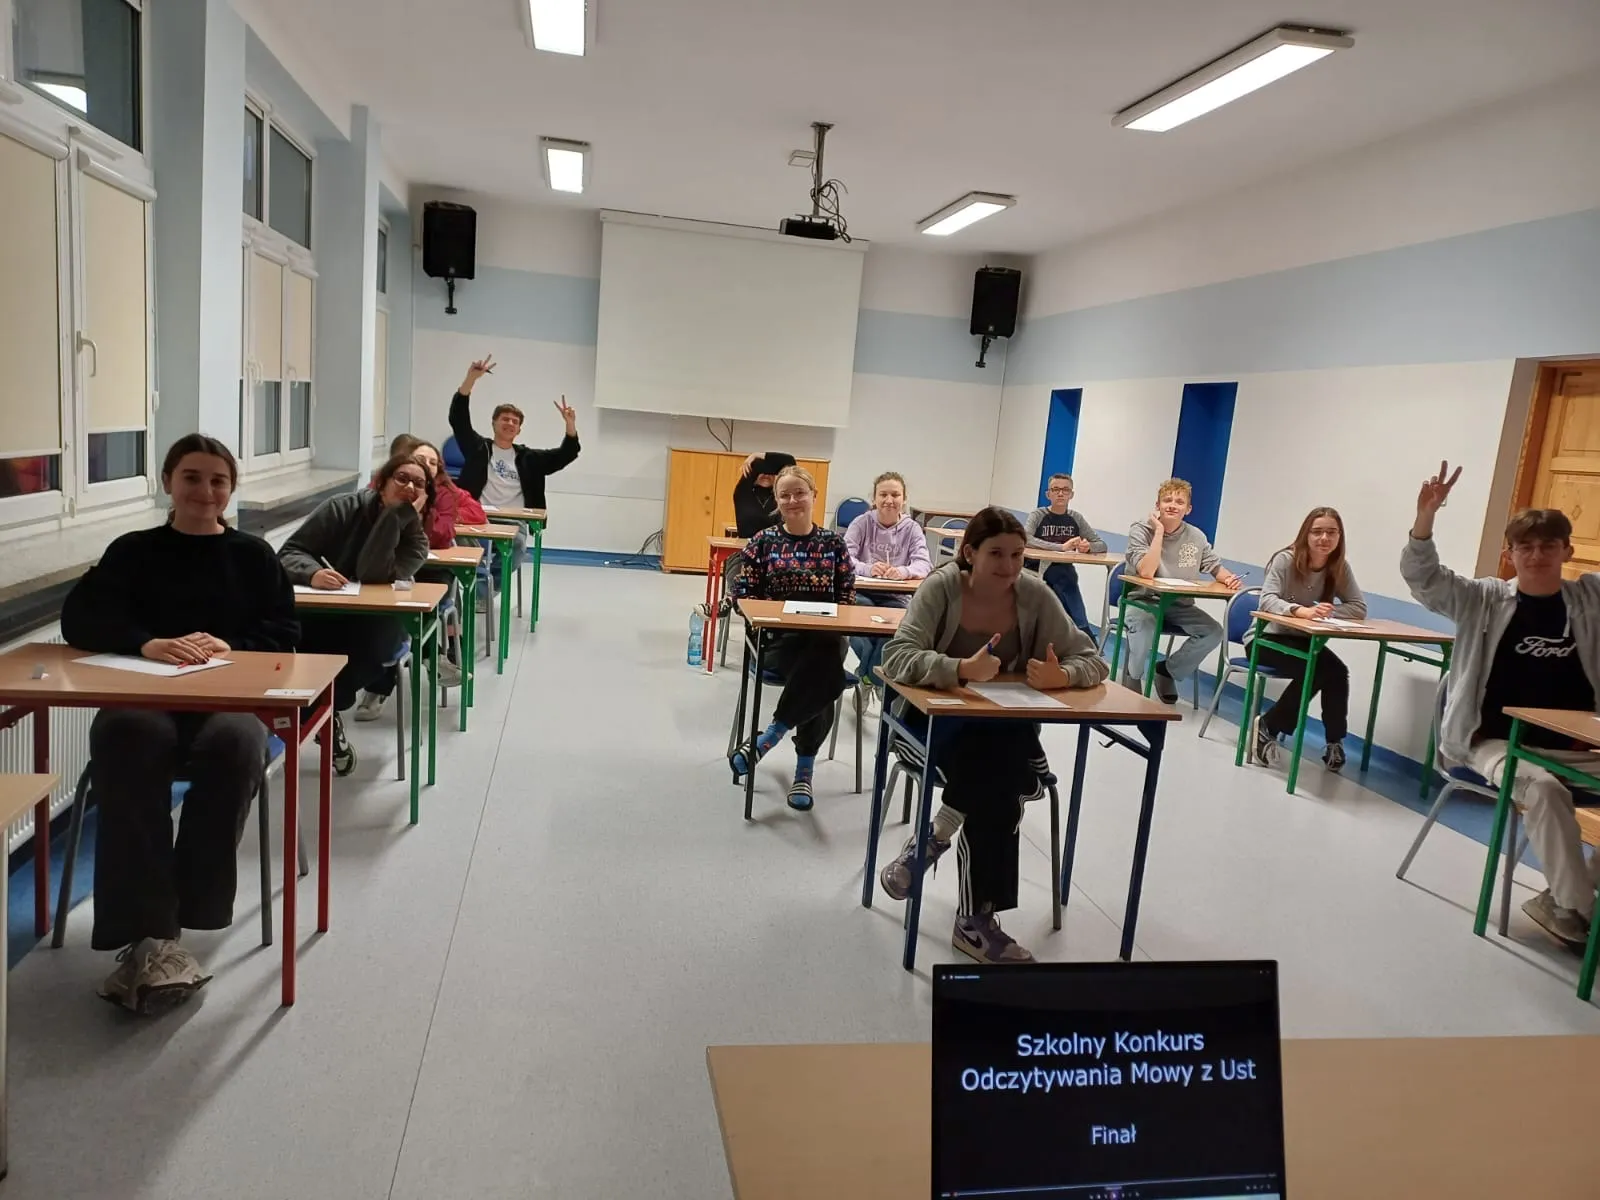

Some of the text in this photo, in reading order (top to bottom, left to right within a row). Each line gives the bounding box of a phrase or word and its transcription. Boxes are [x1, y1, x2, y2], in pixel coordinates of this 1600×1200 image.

[1041, 524, 1076, 537] DIVERSE
[1515, 635, 1577, 658] Ford
[1017, 1029, 1205, 1059] Szkolny Konkurs
[961, 1058, 1257, 1094] Odczytywania Mowy z Ust
[1091, 1123, 1137, 1145] Finał
